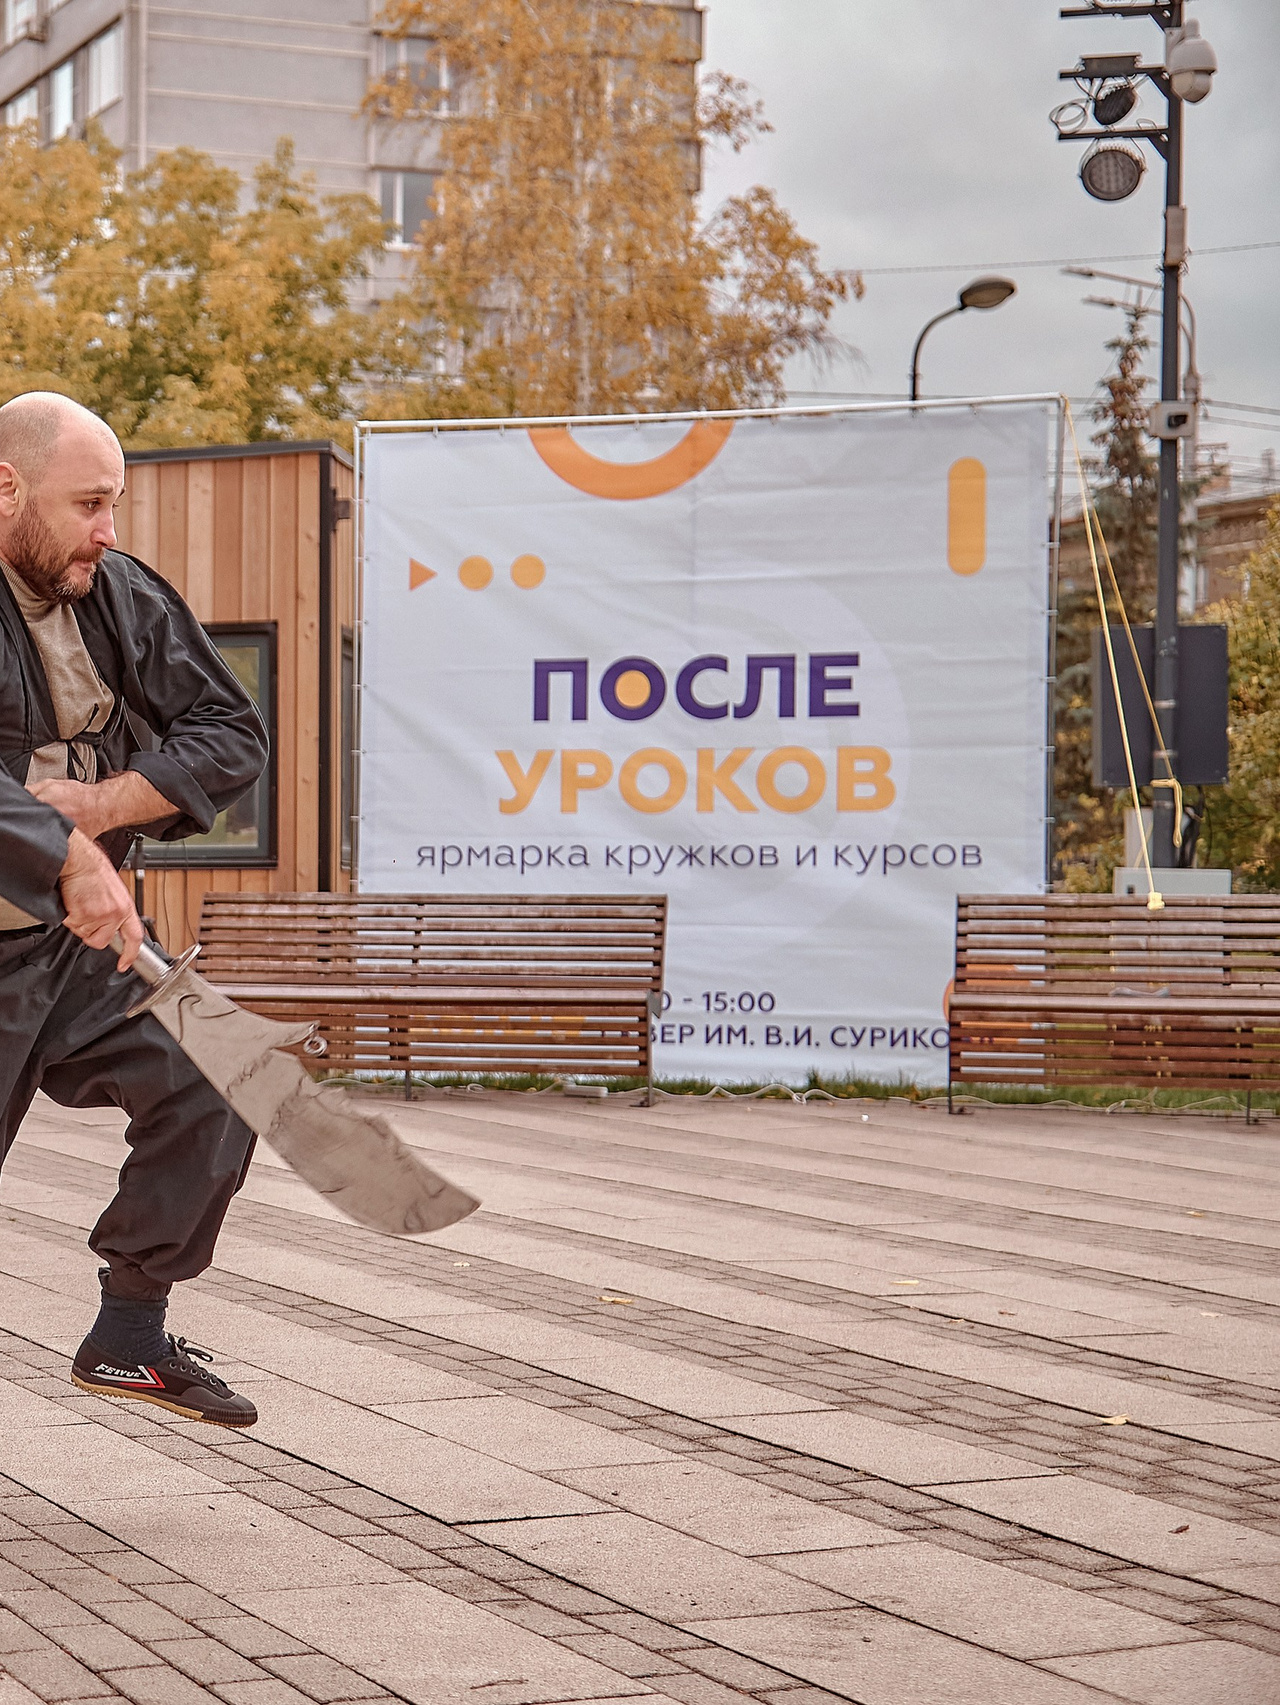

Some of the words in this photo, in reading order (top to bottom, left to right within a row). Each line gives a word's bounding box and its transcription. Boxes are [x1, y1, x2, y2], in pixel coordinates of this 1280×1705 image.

[533, 651, 860, 721] ПОСЛЕ
[495, 745, 897, 815] УРОКОВ
[417, 844, 589, 875] ярмарка
[605, 844, 779, 875] кружков
[796, 845, 818, 867] и
[834, 844, 983, 875] курсов
[702, 991, 776, 1012] 15:00
[705, 1025, 755, 1045] ИМ.
[765, 1026, 821, 1047] В.И.
